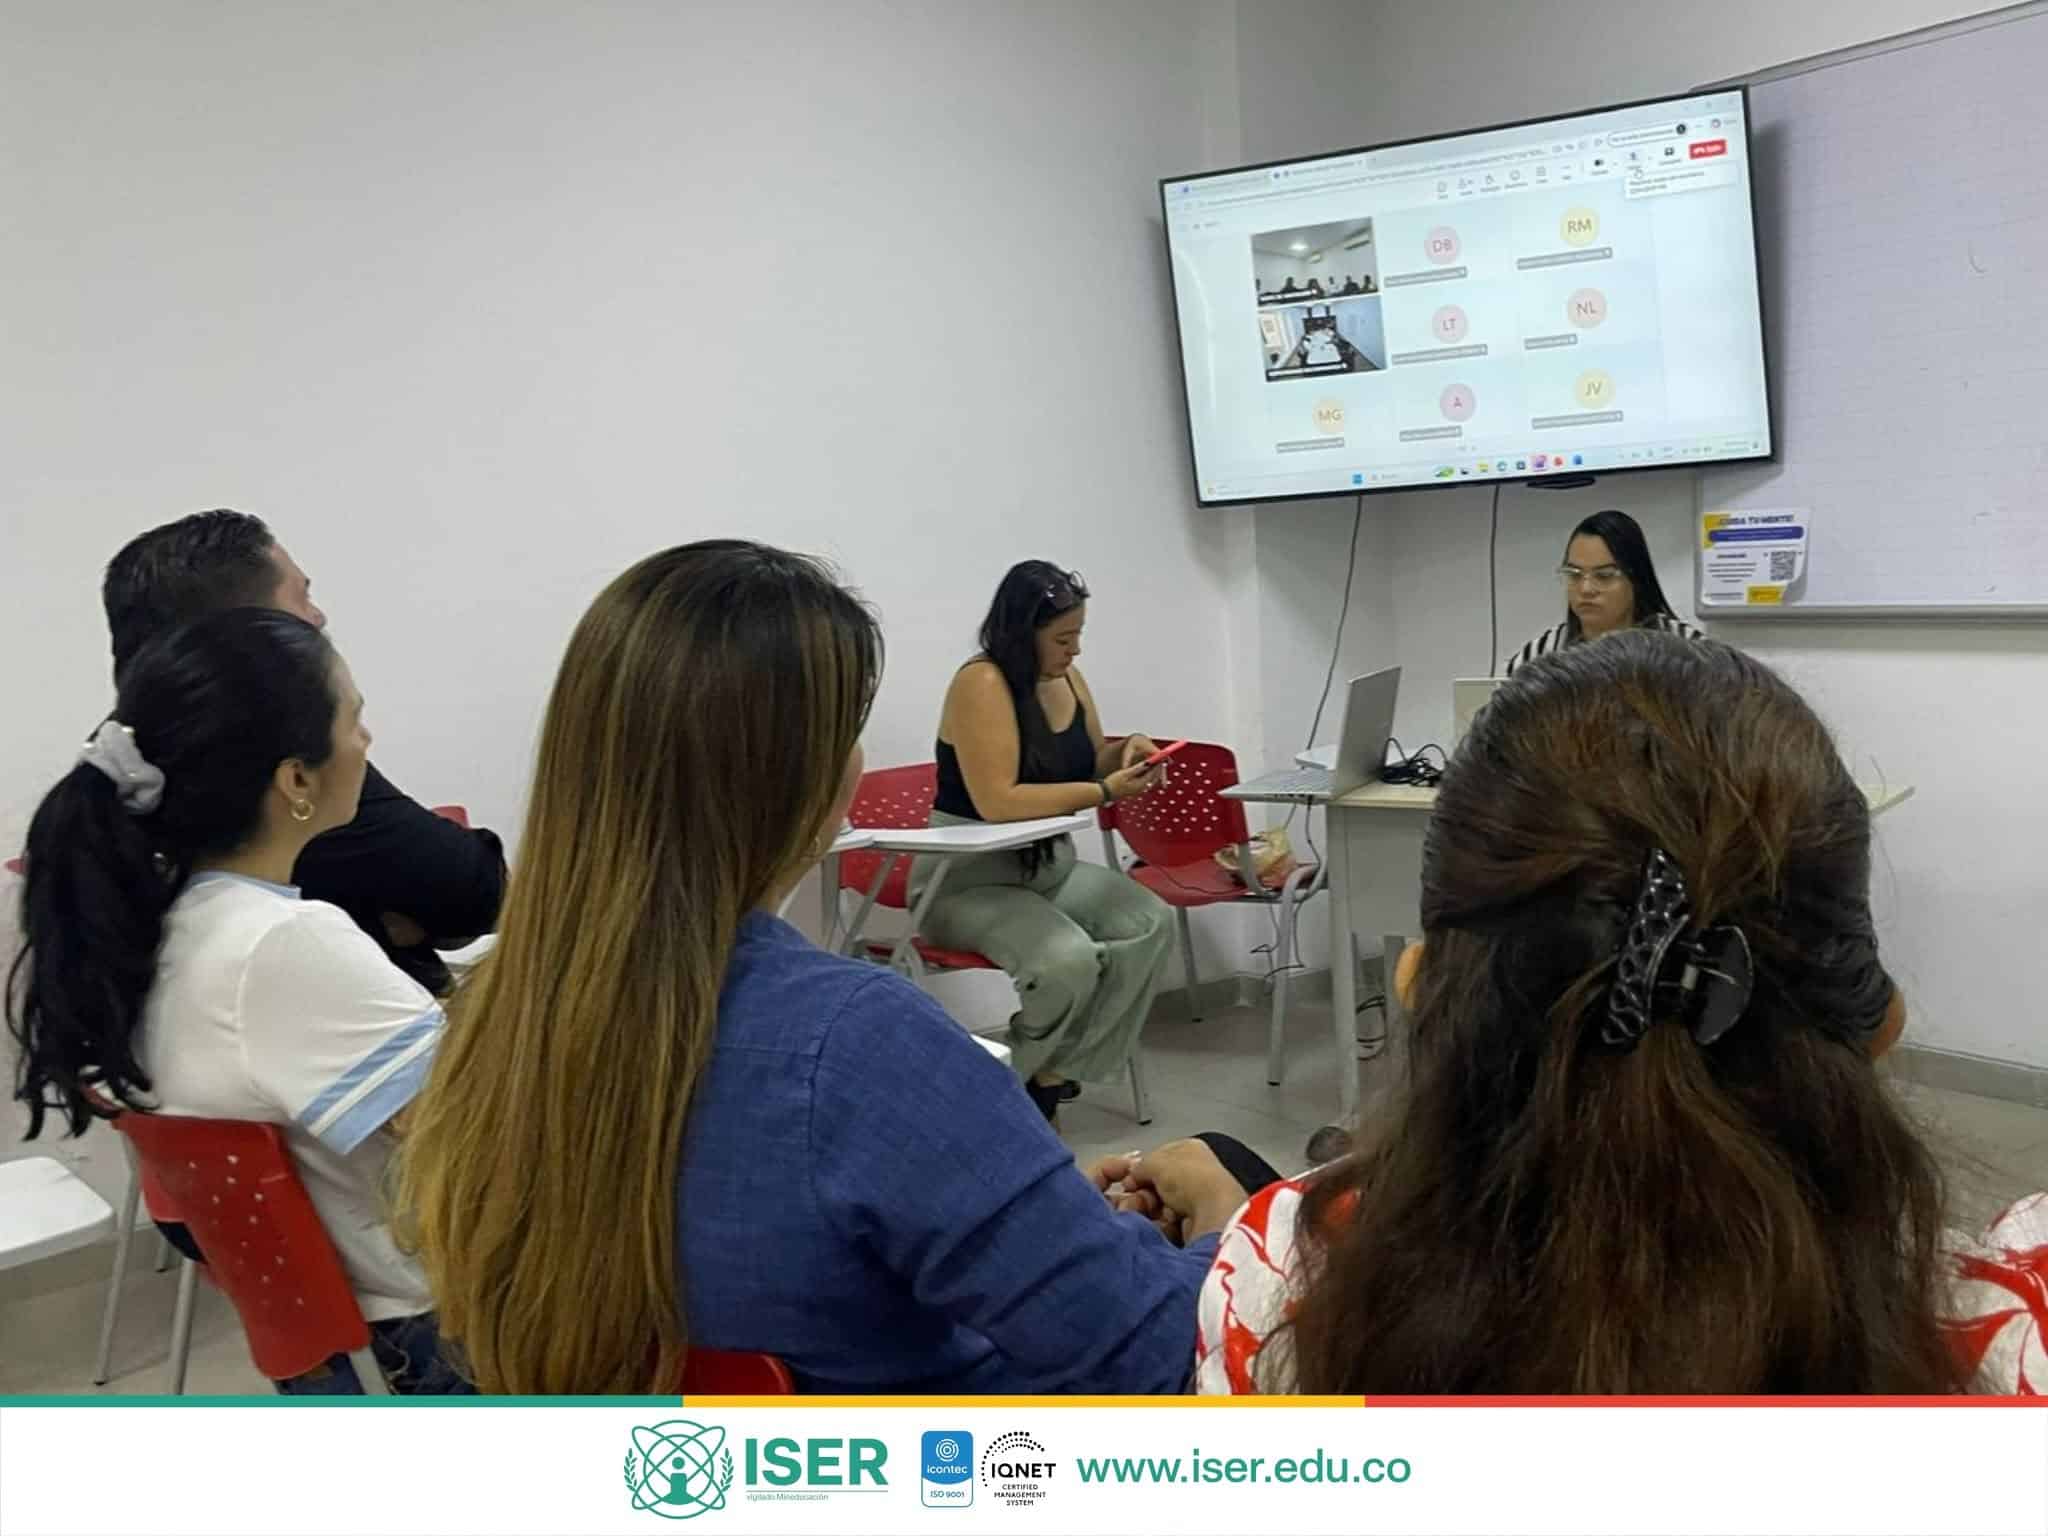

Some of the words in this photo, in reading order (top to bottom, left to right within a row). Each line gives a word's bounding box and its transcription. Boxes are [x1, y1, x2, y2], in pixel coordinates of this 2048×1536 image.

[1567, 218, 1592, 234] RM
[1432, 238, 1451, 253] DB
[1576, 301, 1597, 314] NL
[1442, 317, 1457, 331] LT
[1586, 382, 1601, 396] JV
[1452, 395, 1463, 408] A
[1318, 408, 1342, 423] MG
